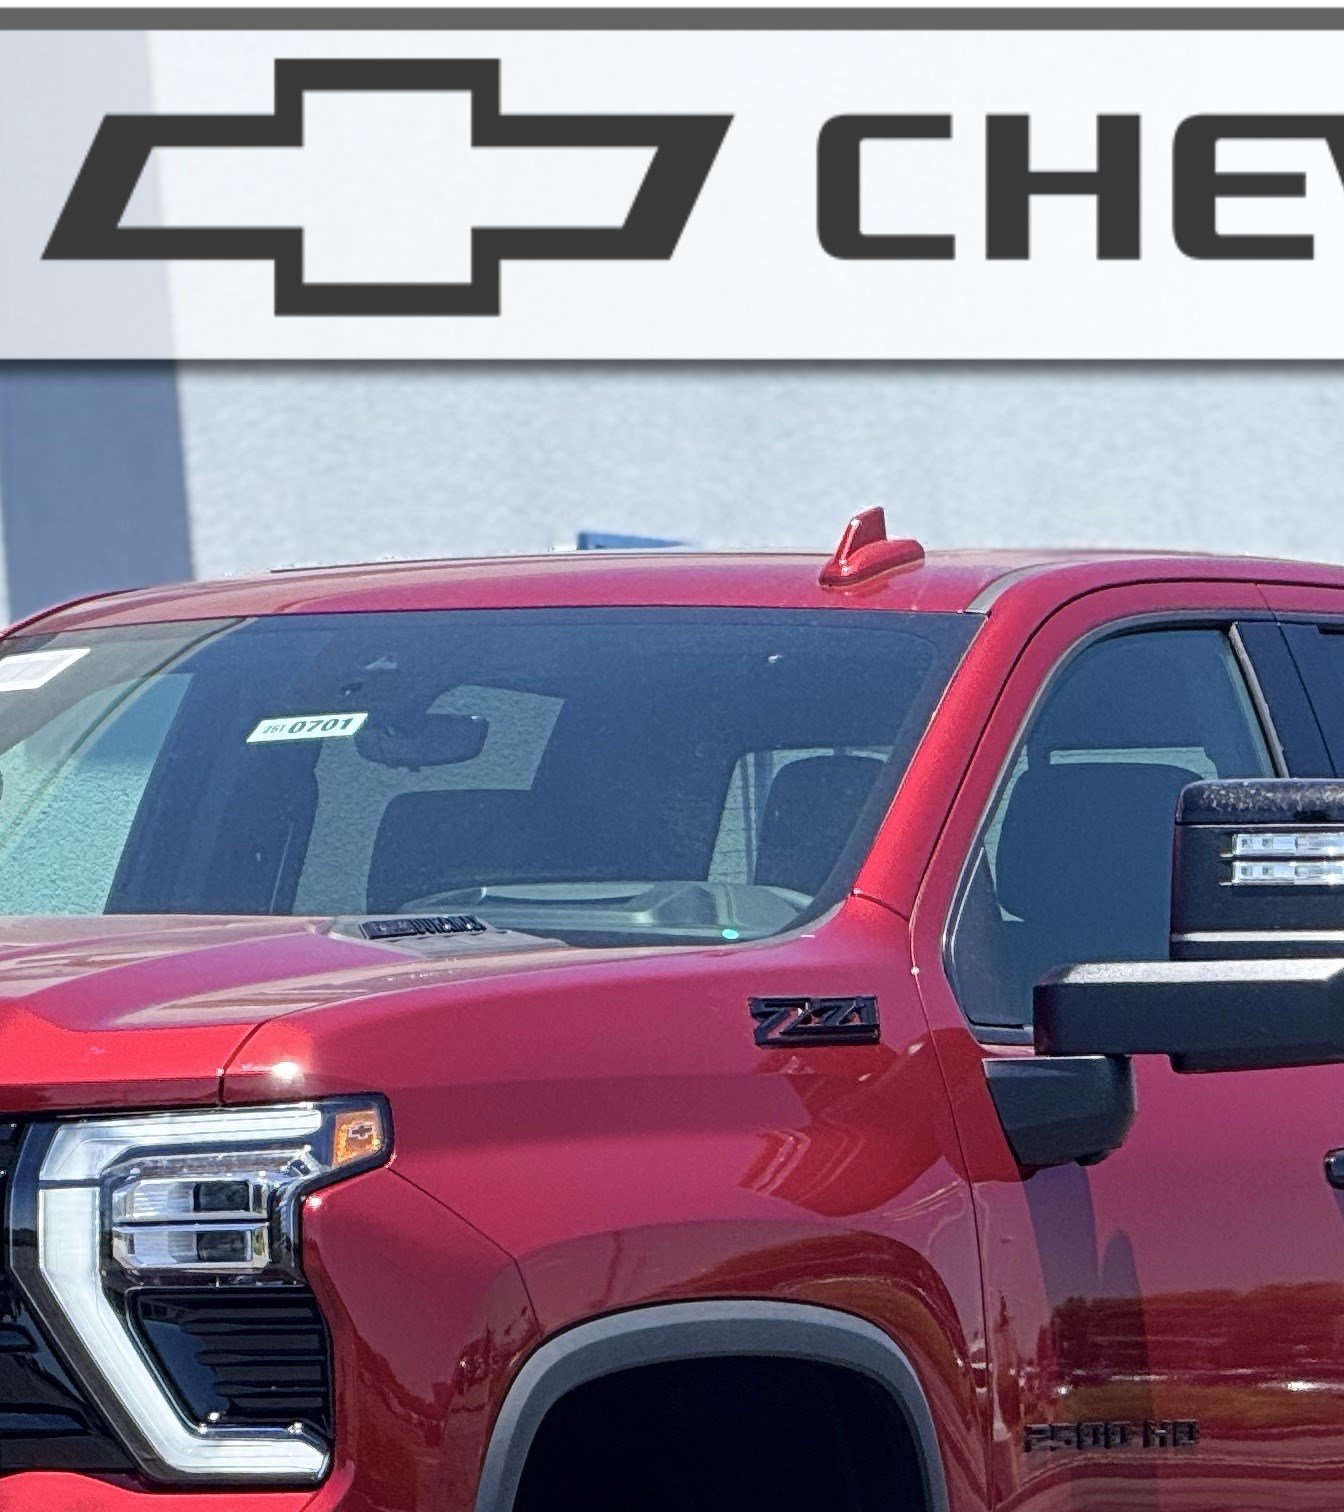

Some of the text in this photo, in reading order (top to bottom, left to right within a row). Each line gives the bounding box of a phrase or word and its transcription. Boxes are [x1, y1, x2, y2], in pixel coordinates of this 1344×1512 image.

[288, 717, 354, 734] 0701
[748, 994, 881, 1050] Z71
[1024, 1418, 1200, 1452] 2500 HD
